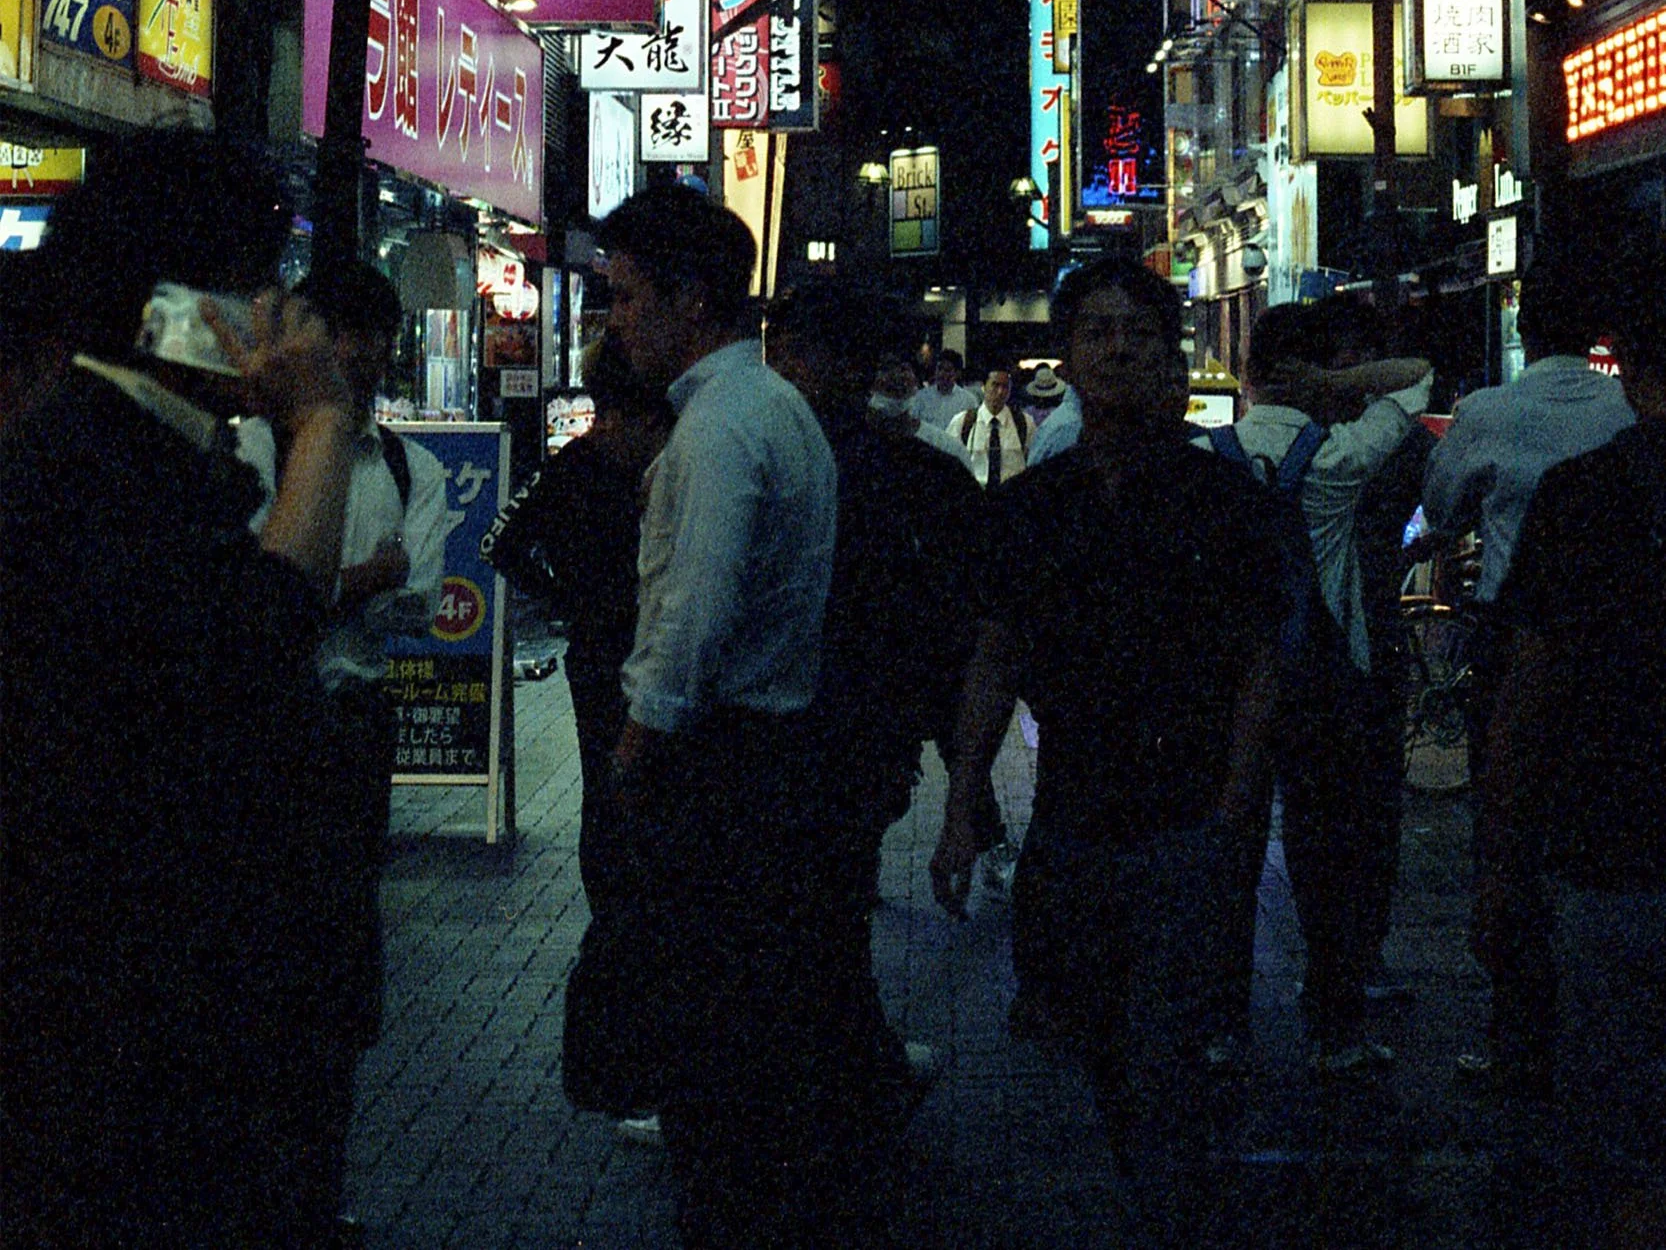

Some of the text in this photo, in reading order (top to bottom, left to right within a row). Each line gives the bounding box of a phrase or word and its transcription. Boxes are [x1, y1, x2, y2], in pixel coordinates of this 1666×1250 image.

[102, 11, 122, 54] 4F
[1450, 63, 1477, 76] B1F
[897, 161, 933, 190] Brick
[436, 593, 473, 622] 4F
